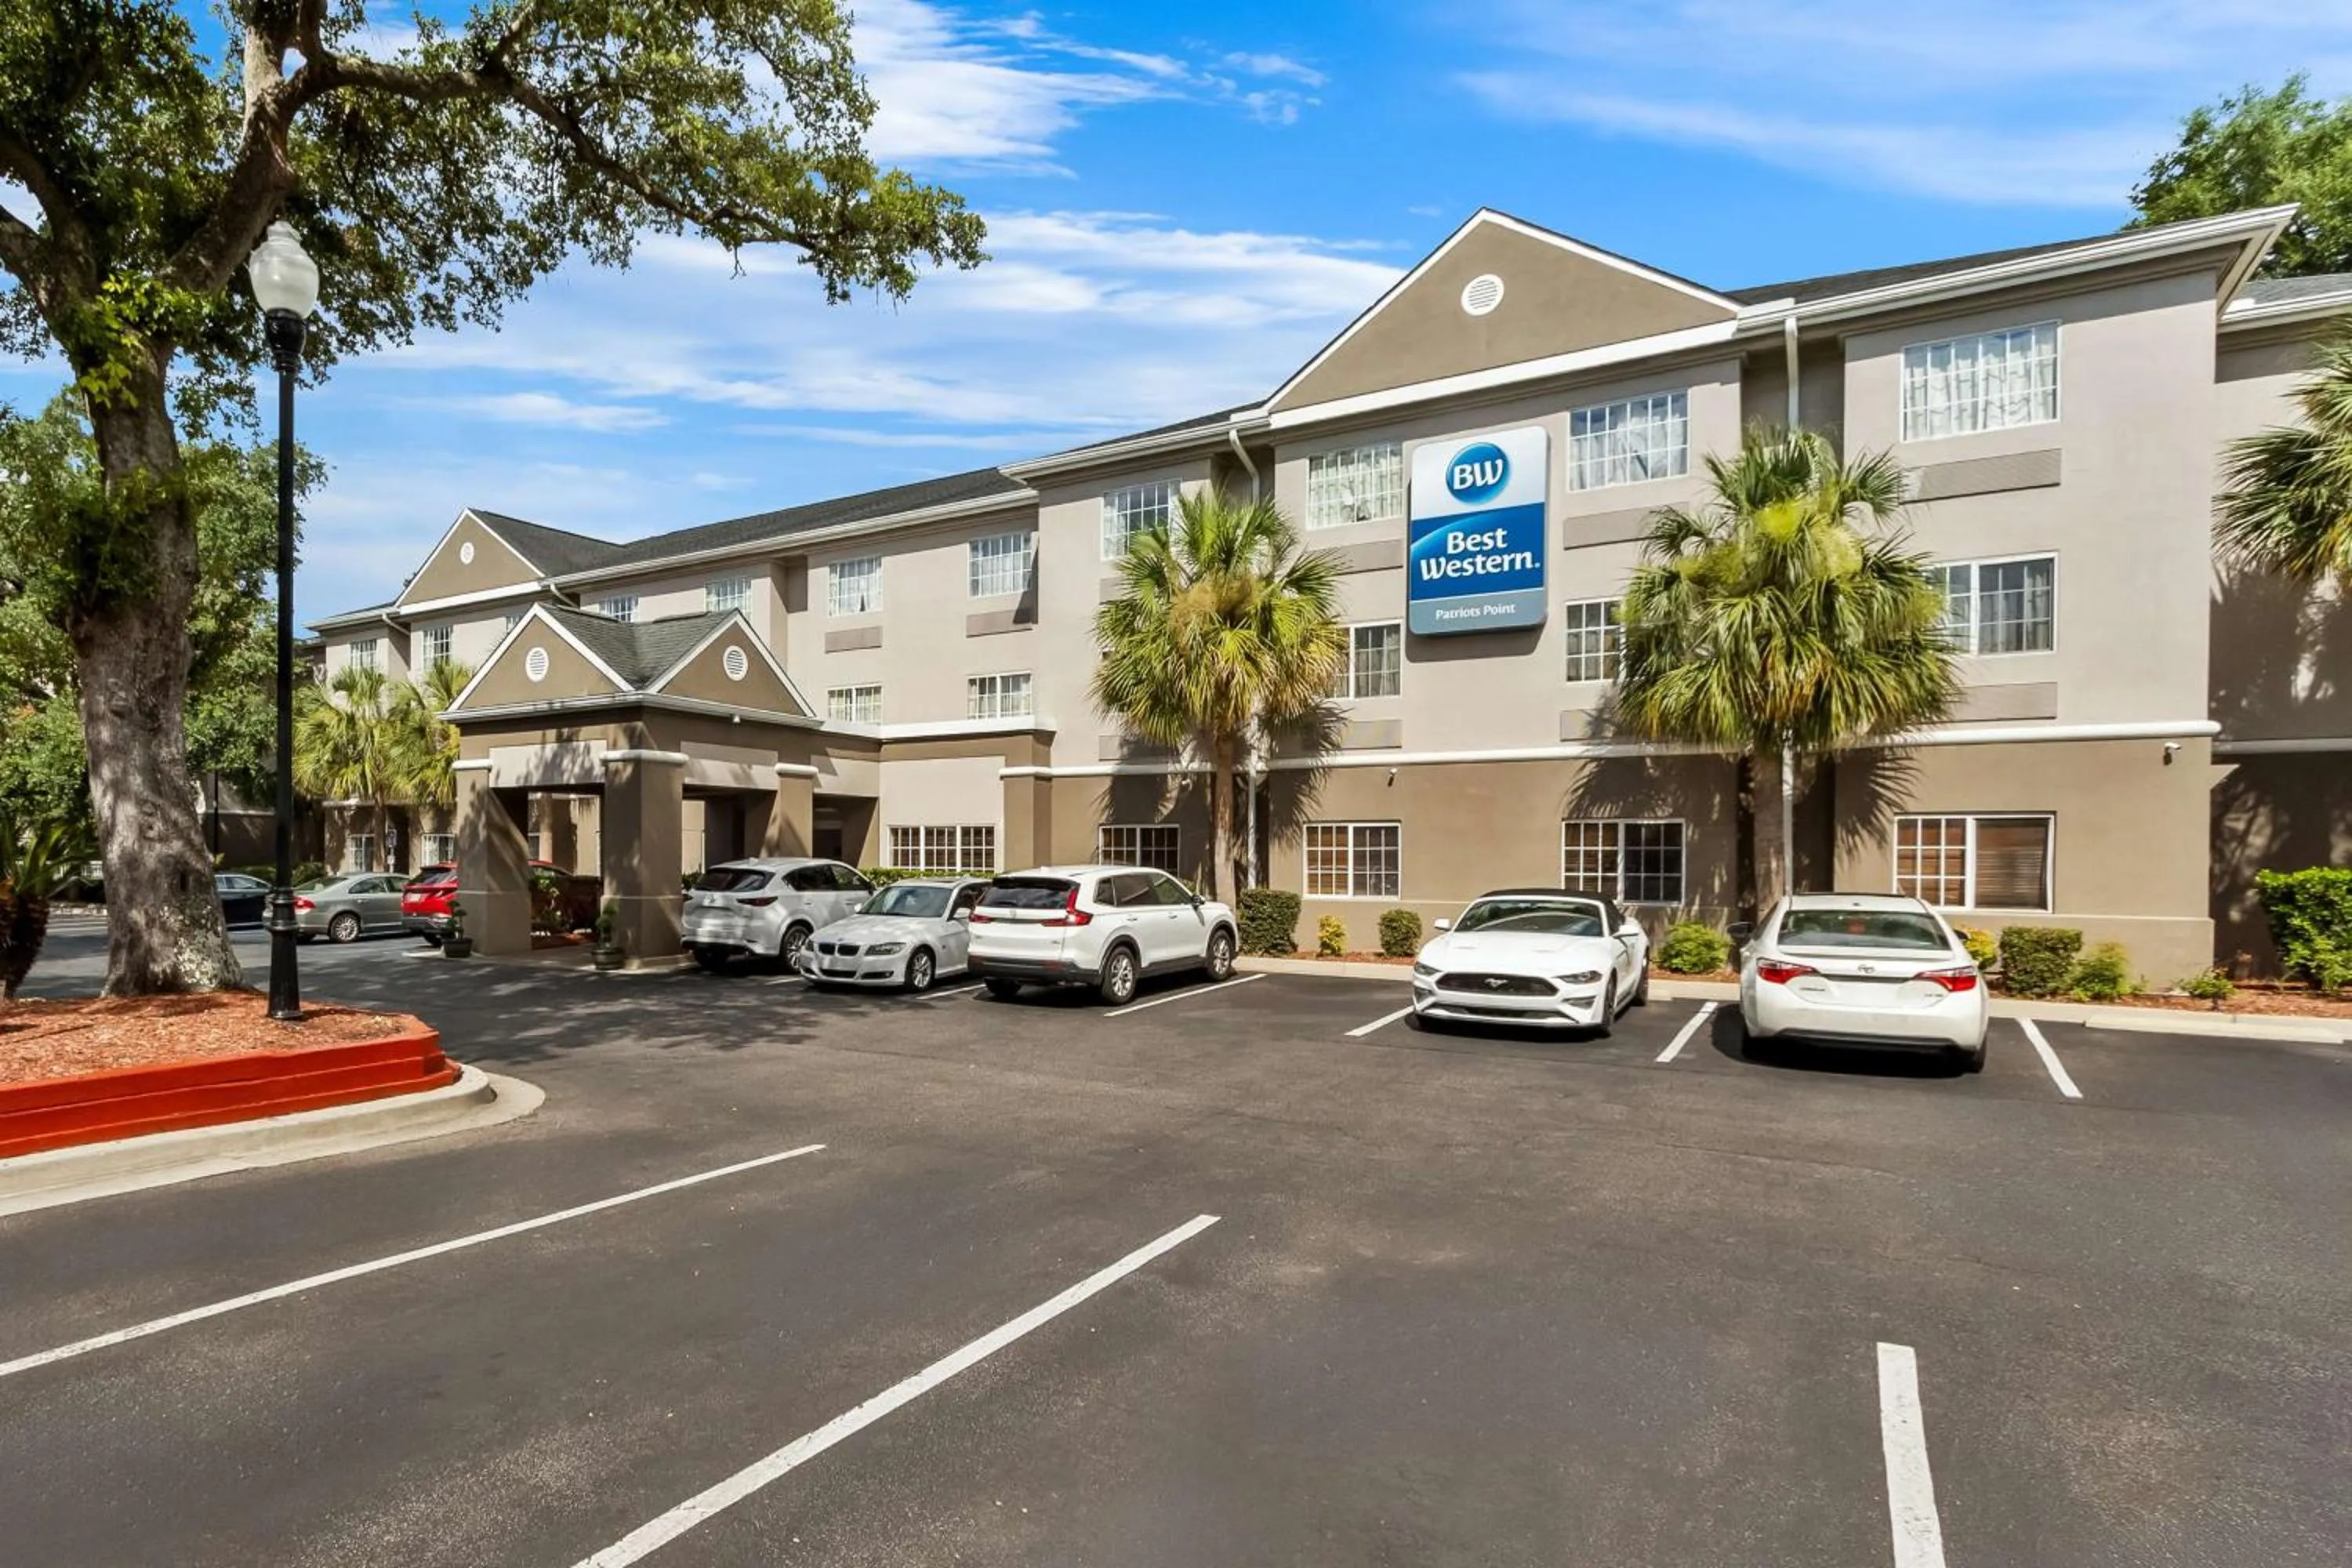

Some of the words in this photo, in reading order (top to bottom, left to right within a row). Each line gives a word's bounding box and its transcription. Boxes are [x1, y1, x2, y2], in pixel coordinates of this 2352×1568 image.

[1453, 459, 1504, 490] BW
[1446, 528, 1508, 554] Best
[1436, 607, 1481, 621] Patriots
[1483, 603, 1516, 615] Point
